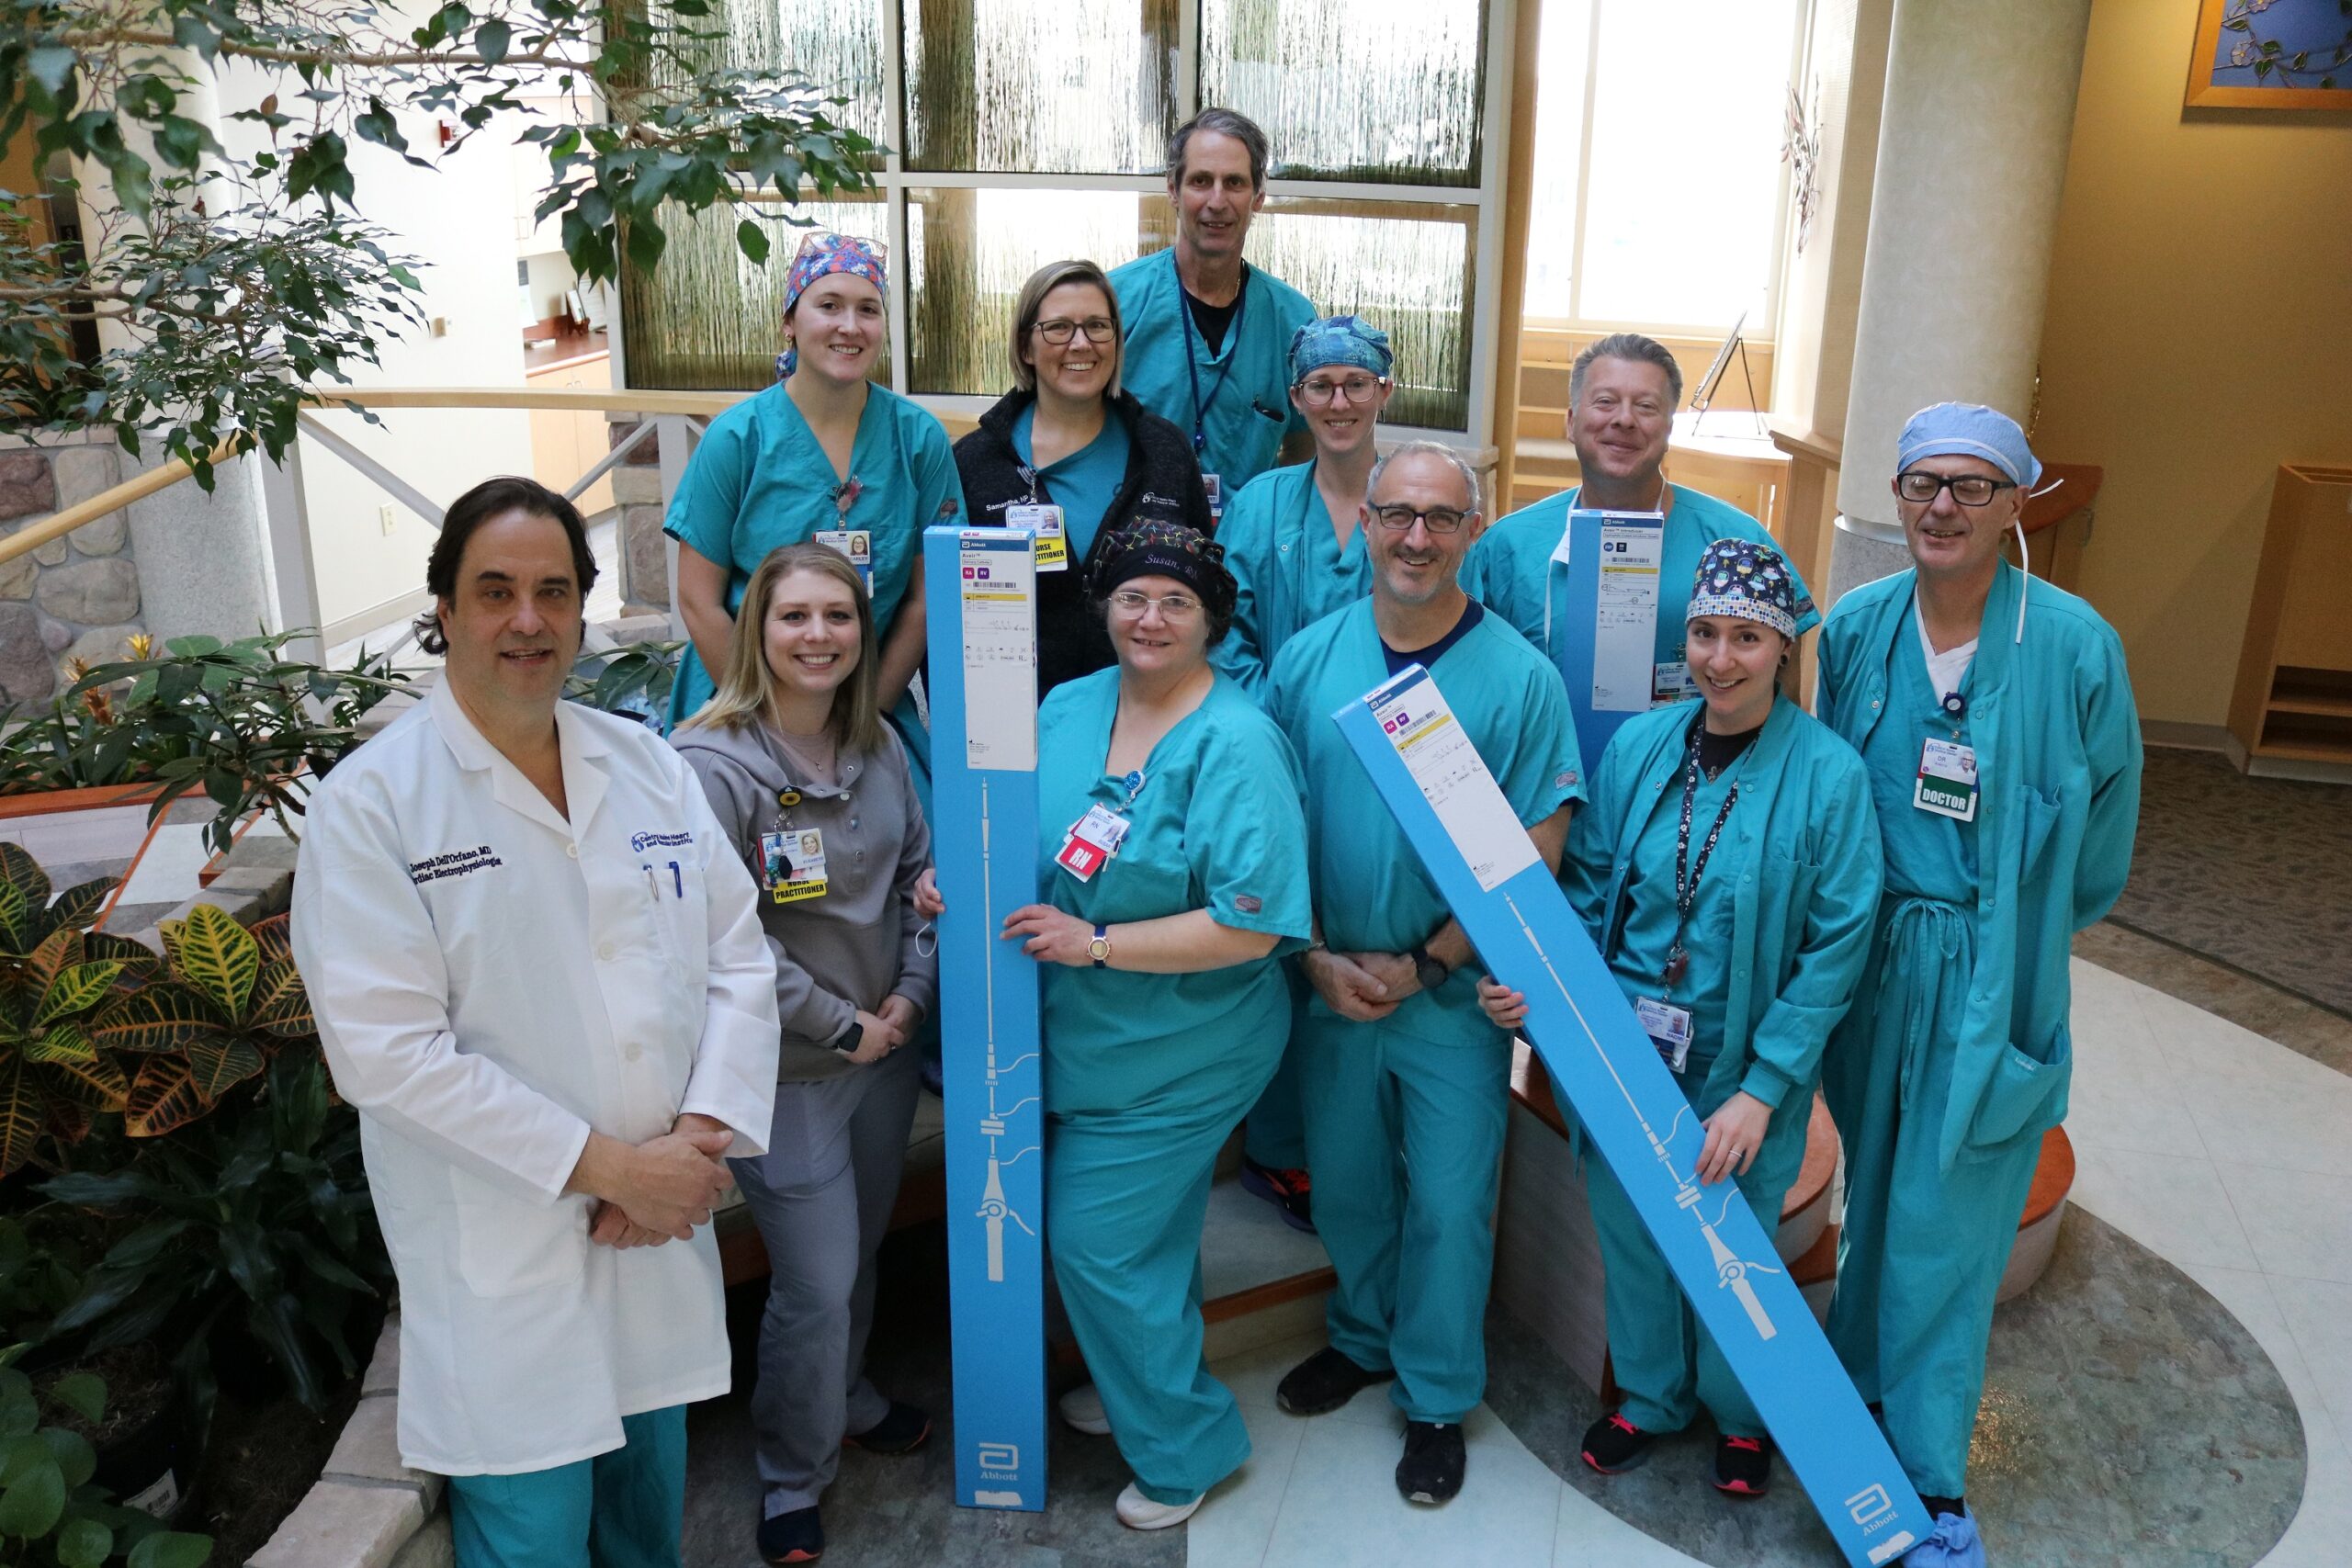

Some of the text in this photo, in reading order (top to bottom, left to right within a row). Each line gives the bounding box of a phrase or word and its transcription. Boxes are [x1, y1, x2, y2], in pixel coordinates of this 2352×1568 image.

[1035, 544, 1051, 552] URSE
[1035, 549, 1065, 561] TITIONER
[1145, 553, 1181, 570] Susan,
[1922, 789, 1966, 810] DOCTOR
[410, 858, 435, 874] Joseph
[479, 845, 492, 855] MD
[1069, 847, 1093, 870] RN
[413, 872, 435, 886] rdiac
[775, 884, 825, 899] PRACTITIONER
[979, 1471, 1019, 1482] Abbott
[1862, 1510, 1899, 1537] Abbott
